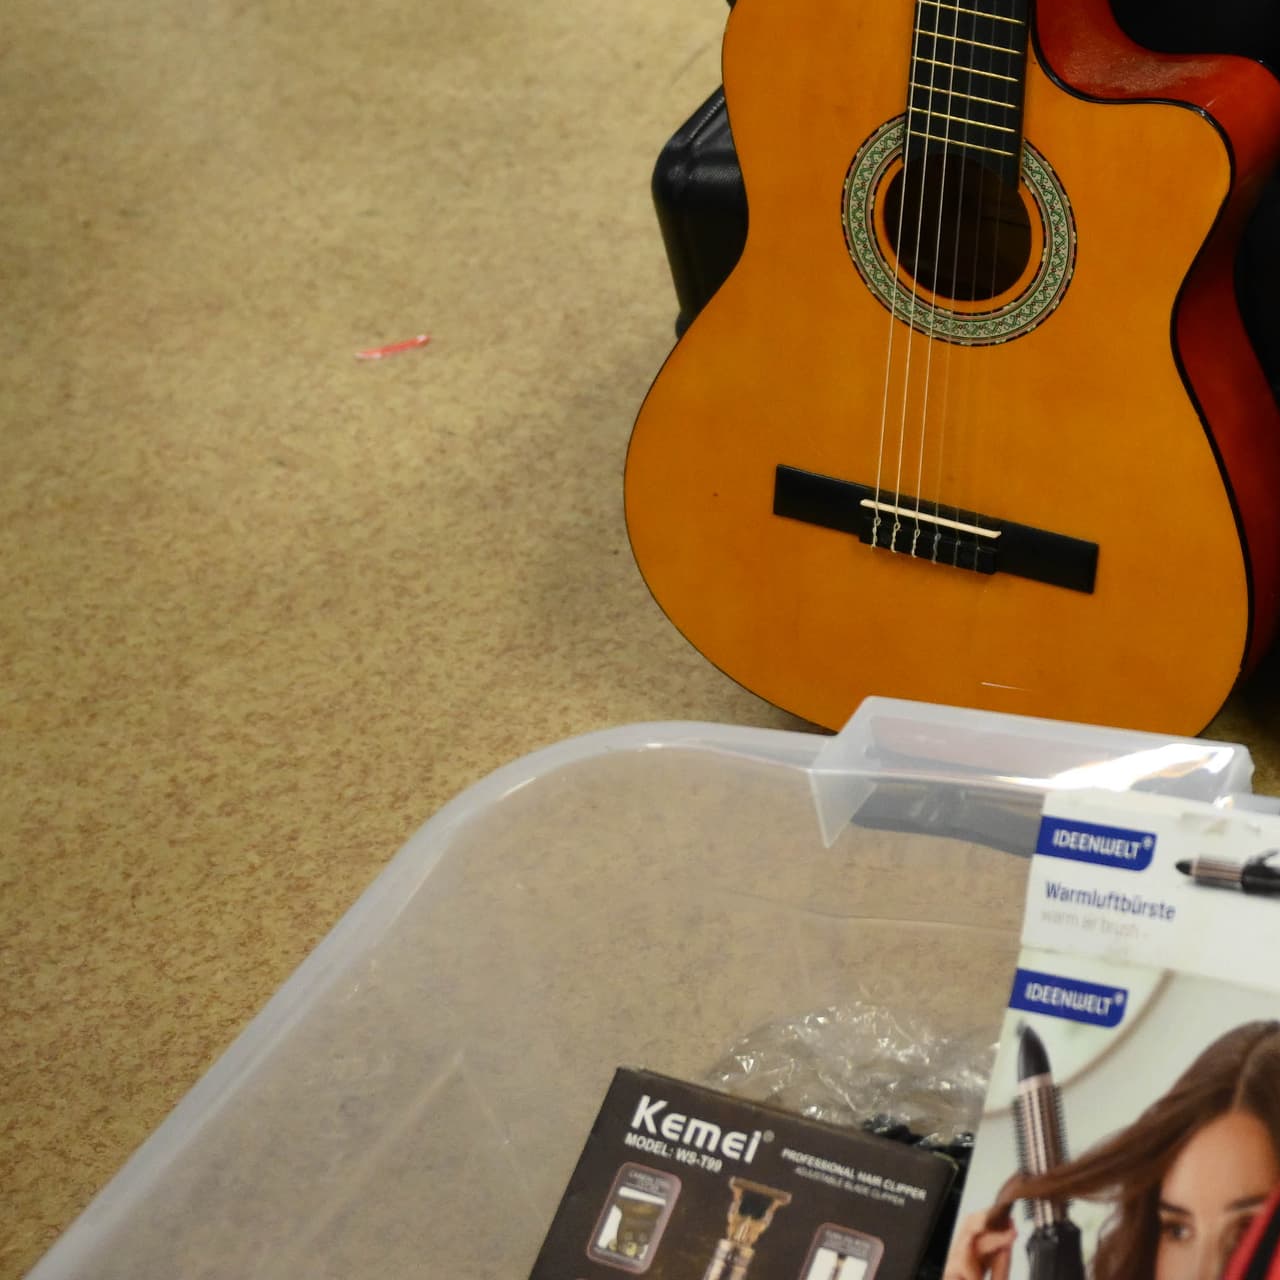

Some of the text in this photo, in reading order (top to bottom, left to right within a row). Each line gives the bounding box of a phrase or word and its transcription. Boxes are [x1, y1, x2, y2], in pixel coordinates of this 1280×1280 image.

[1052, 829, 1141, 860] IDEENWELT
[1045, 879, 1176, 921] Warmluftbürste
[1025, 982, 1112, 1016] IDEENWELT
[624, 1131, 673, 1159] MODEL:
[631, 1094, 762, 1163] Kemei
[781, 1148, 928, 1201] PROFESSIONAL HAIR CLIPPER
